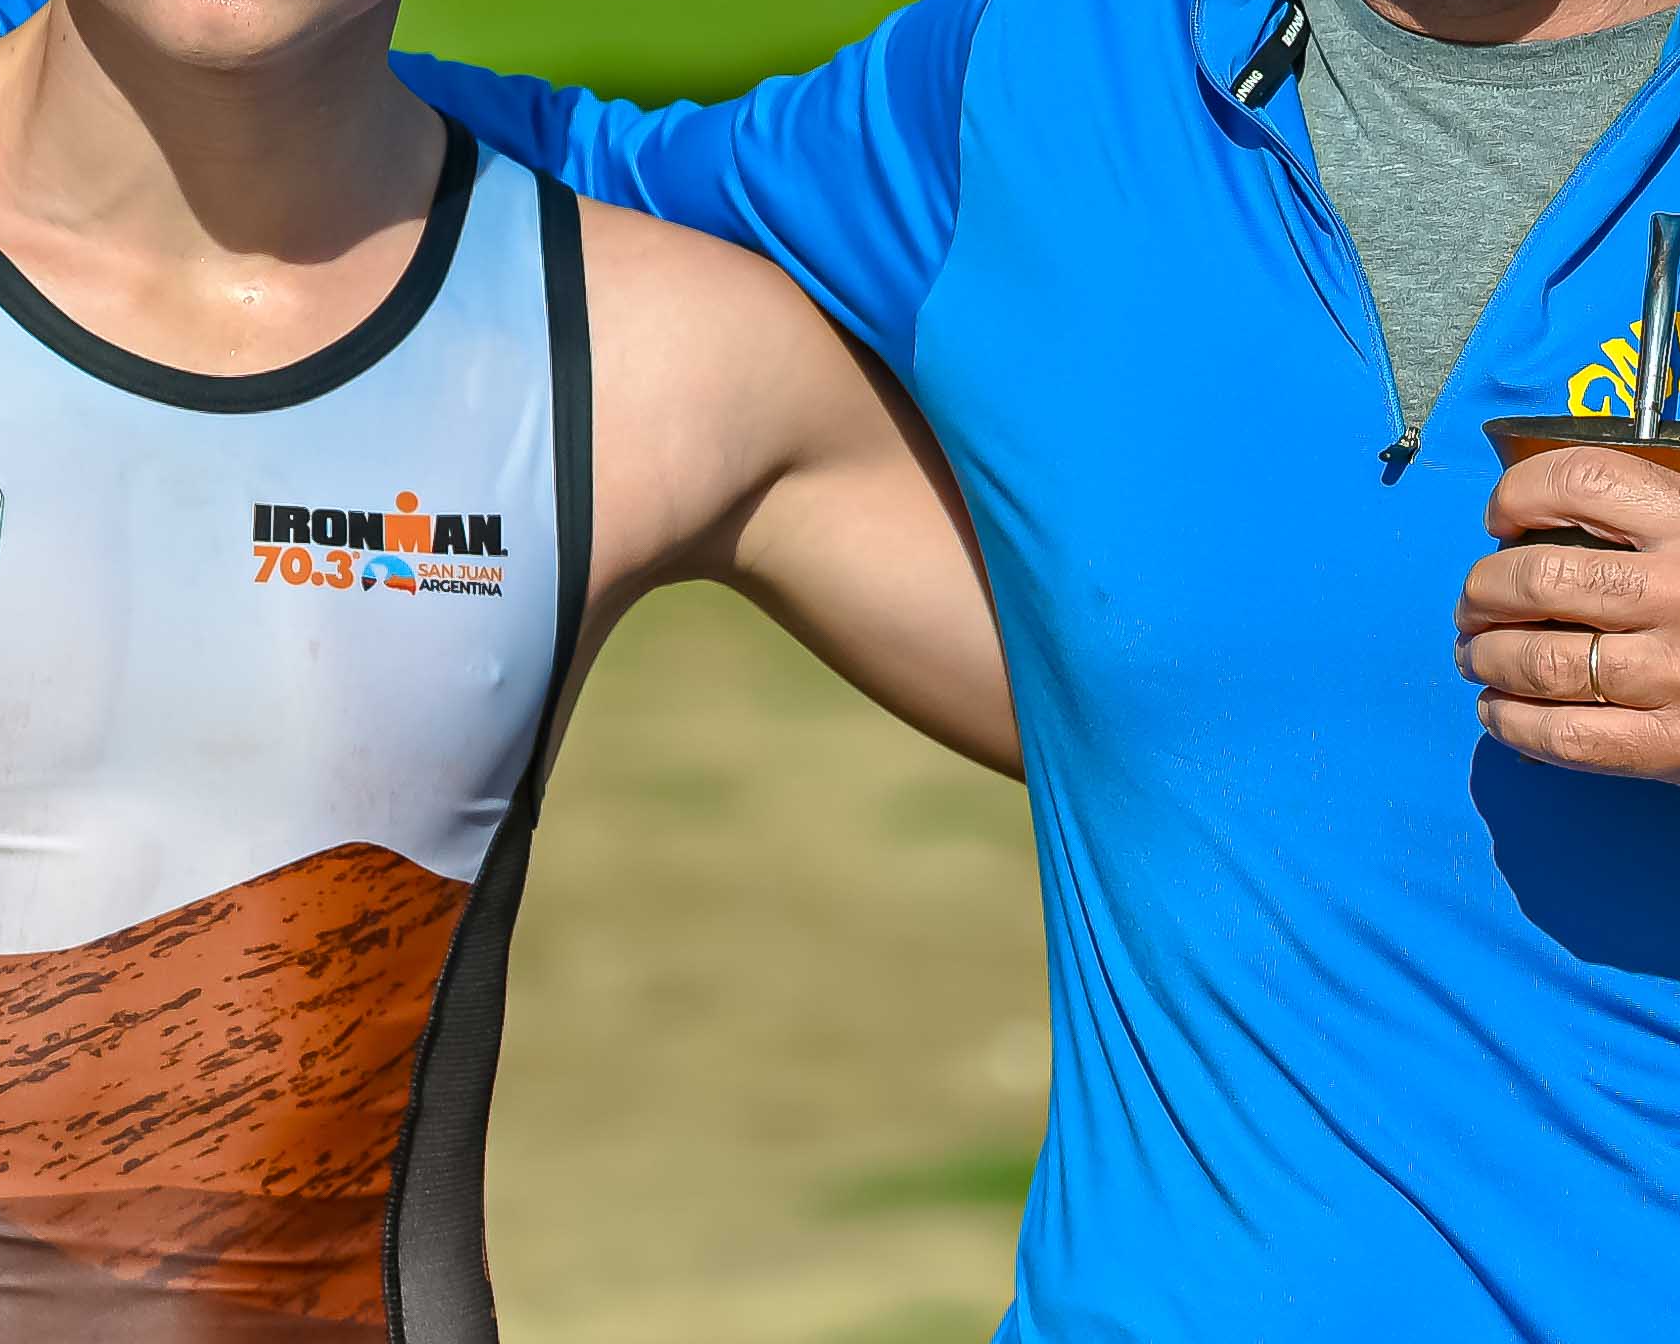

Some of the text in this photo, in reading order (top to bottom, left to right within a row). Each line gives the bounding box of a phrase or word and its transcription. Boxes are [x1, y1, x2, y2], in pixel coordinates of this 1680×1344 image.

[252, 490, 505, 557] IRONMAN
[252, 545, 355, 590] 70.3
[417, 562, 503, 583] SAN JUAN
[418, 579, 503, 598] ARGENTINA
